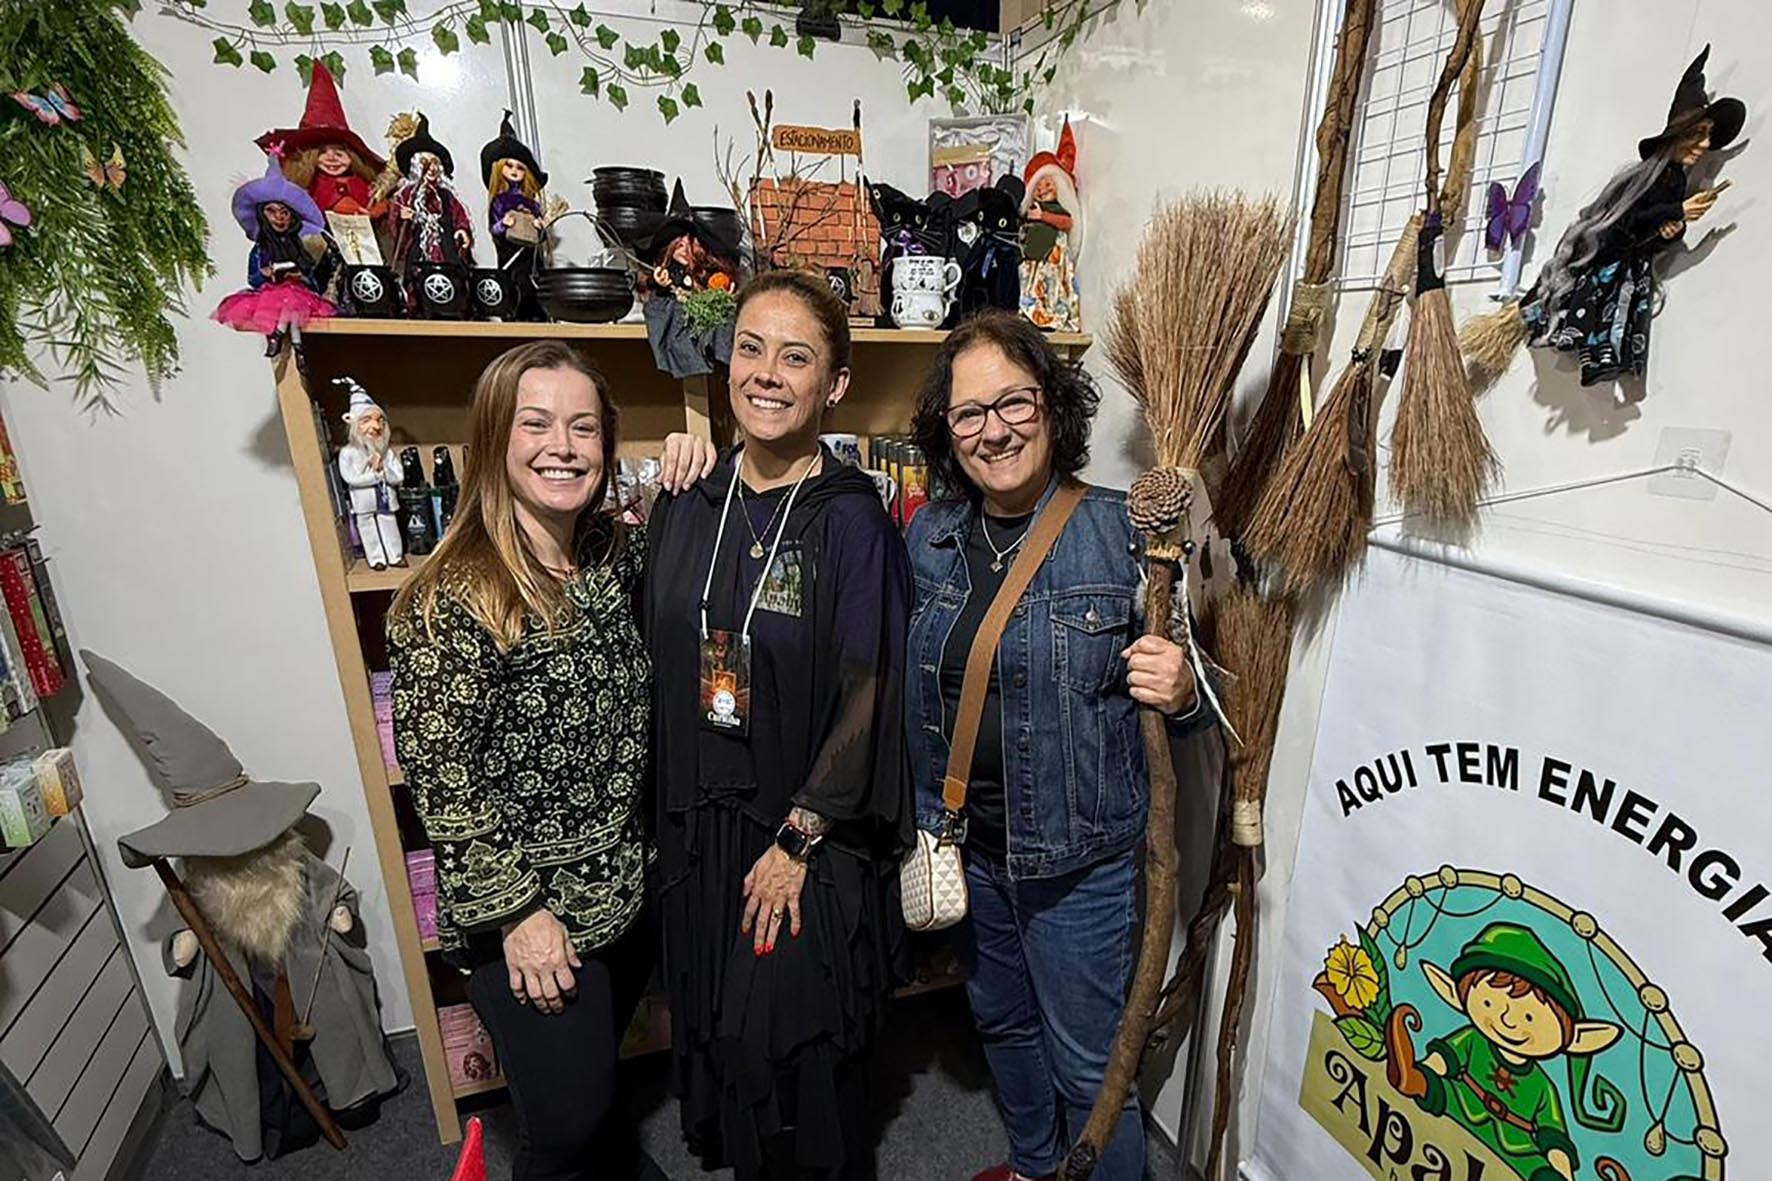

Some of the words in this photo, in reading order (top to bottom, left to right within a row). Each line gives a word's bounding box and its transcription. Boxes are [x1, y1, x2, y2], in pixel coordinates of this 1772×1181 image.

[780, 129, 854, 150] ESTACIONAMENTO
[1335, 749, 1418, 818] AQUI
[1425, 742, 1519, 791] TEM
